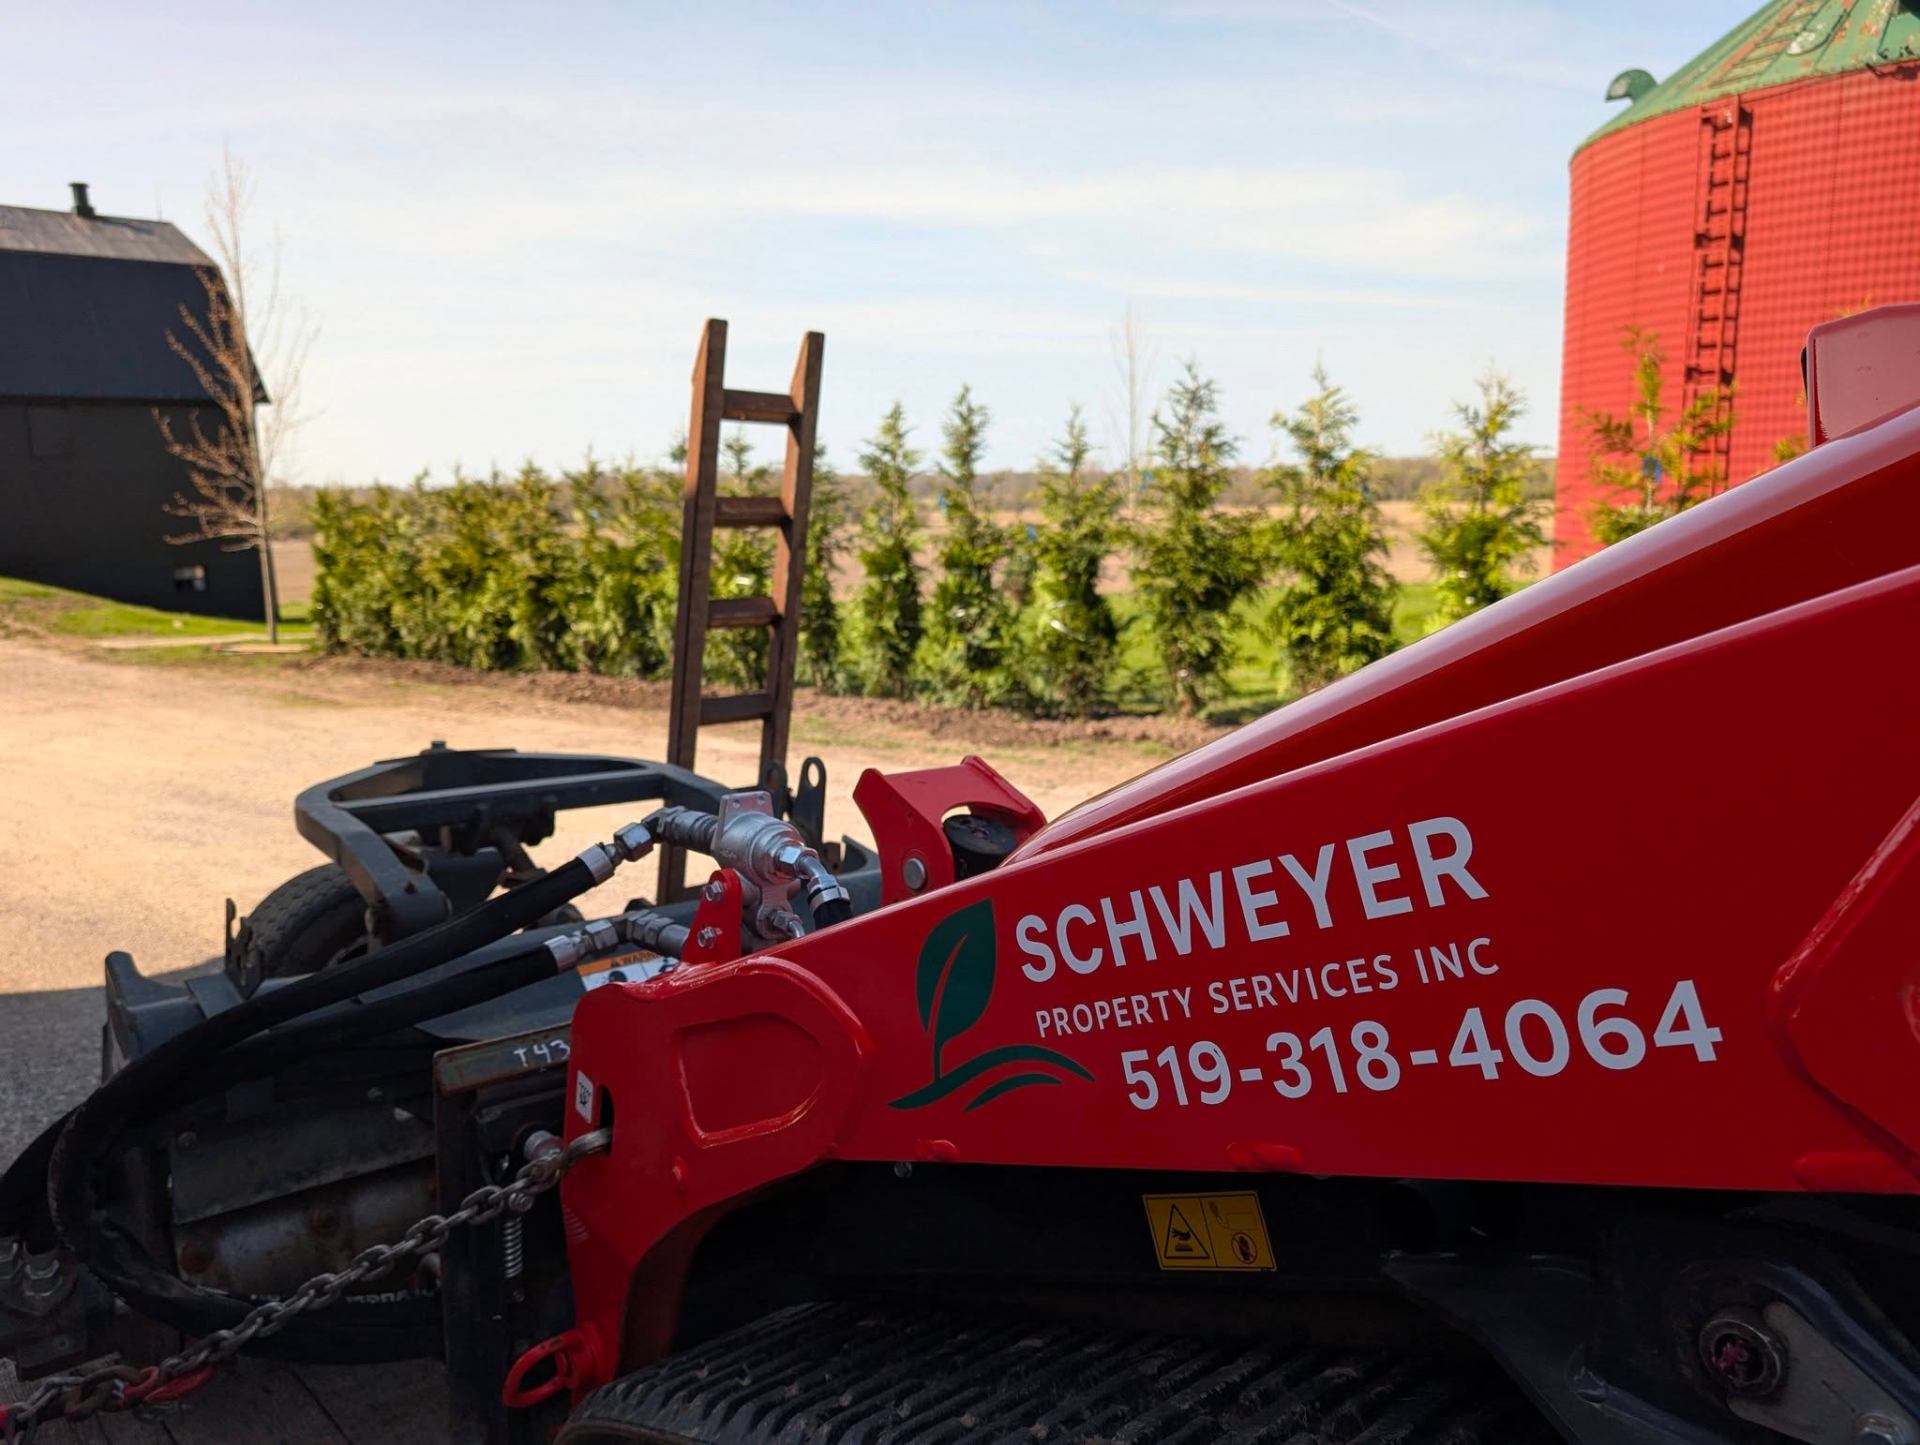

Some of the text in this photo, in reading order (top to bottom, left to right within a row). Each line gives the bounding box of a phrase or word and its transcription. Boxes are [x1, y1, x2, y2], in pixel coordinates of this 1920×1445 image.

[1016, 815, 1489, 982] SCHWEYER
[1036, 938, 1500, 1038] PROPERTY SERVICES INC
[1121, 980, 1723, 1110] 519-318-4064
